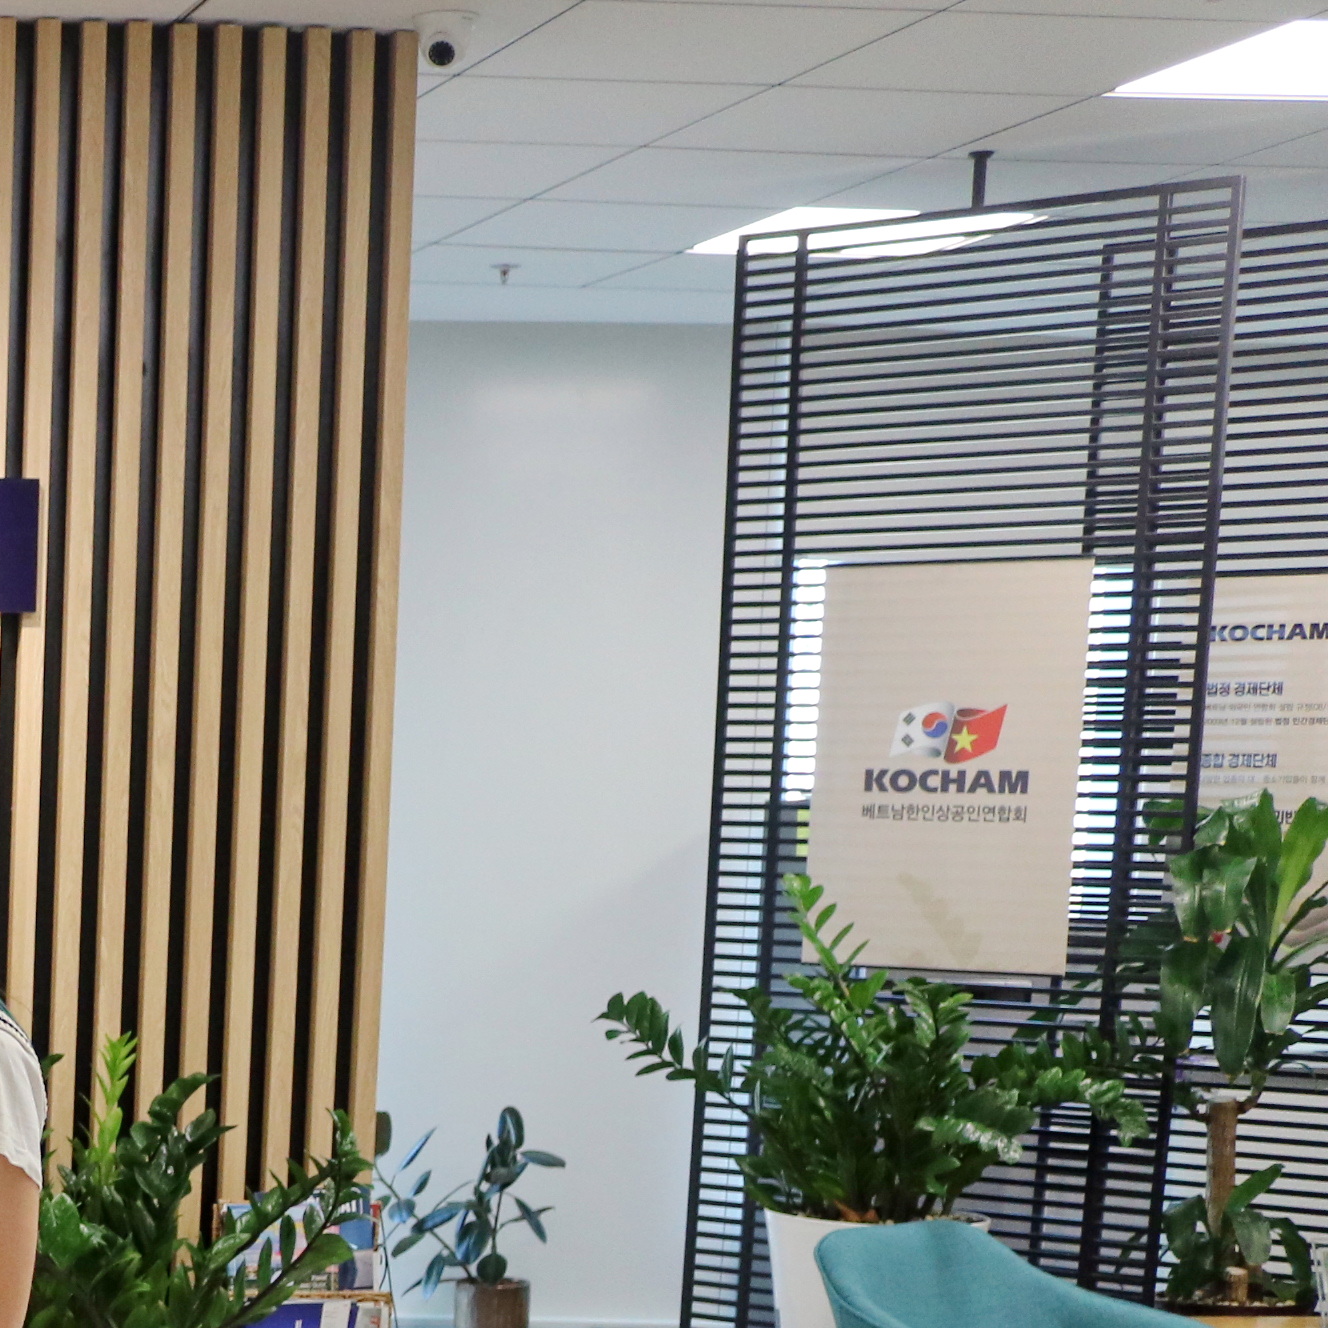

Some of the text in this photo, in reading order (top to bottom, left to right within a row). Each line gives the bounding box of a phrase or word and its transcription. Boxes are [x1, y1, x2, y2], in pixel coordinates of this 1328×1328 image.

[1209, 623, 1328, 642] KOCHAM
[1234, 681, 1284, 697] 경제단체
[1228, 753, 1278, 768] 경제단체
[864, 768, 1030, 794] KOCHAM
[861, 804, 1028, 823] 베트남한인상공인연합회
